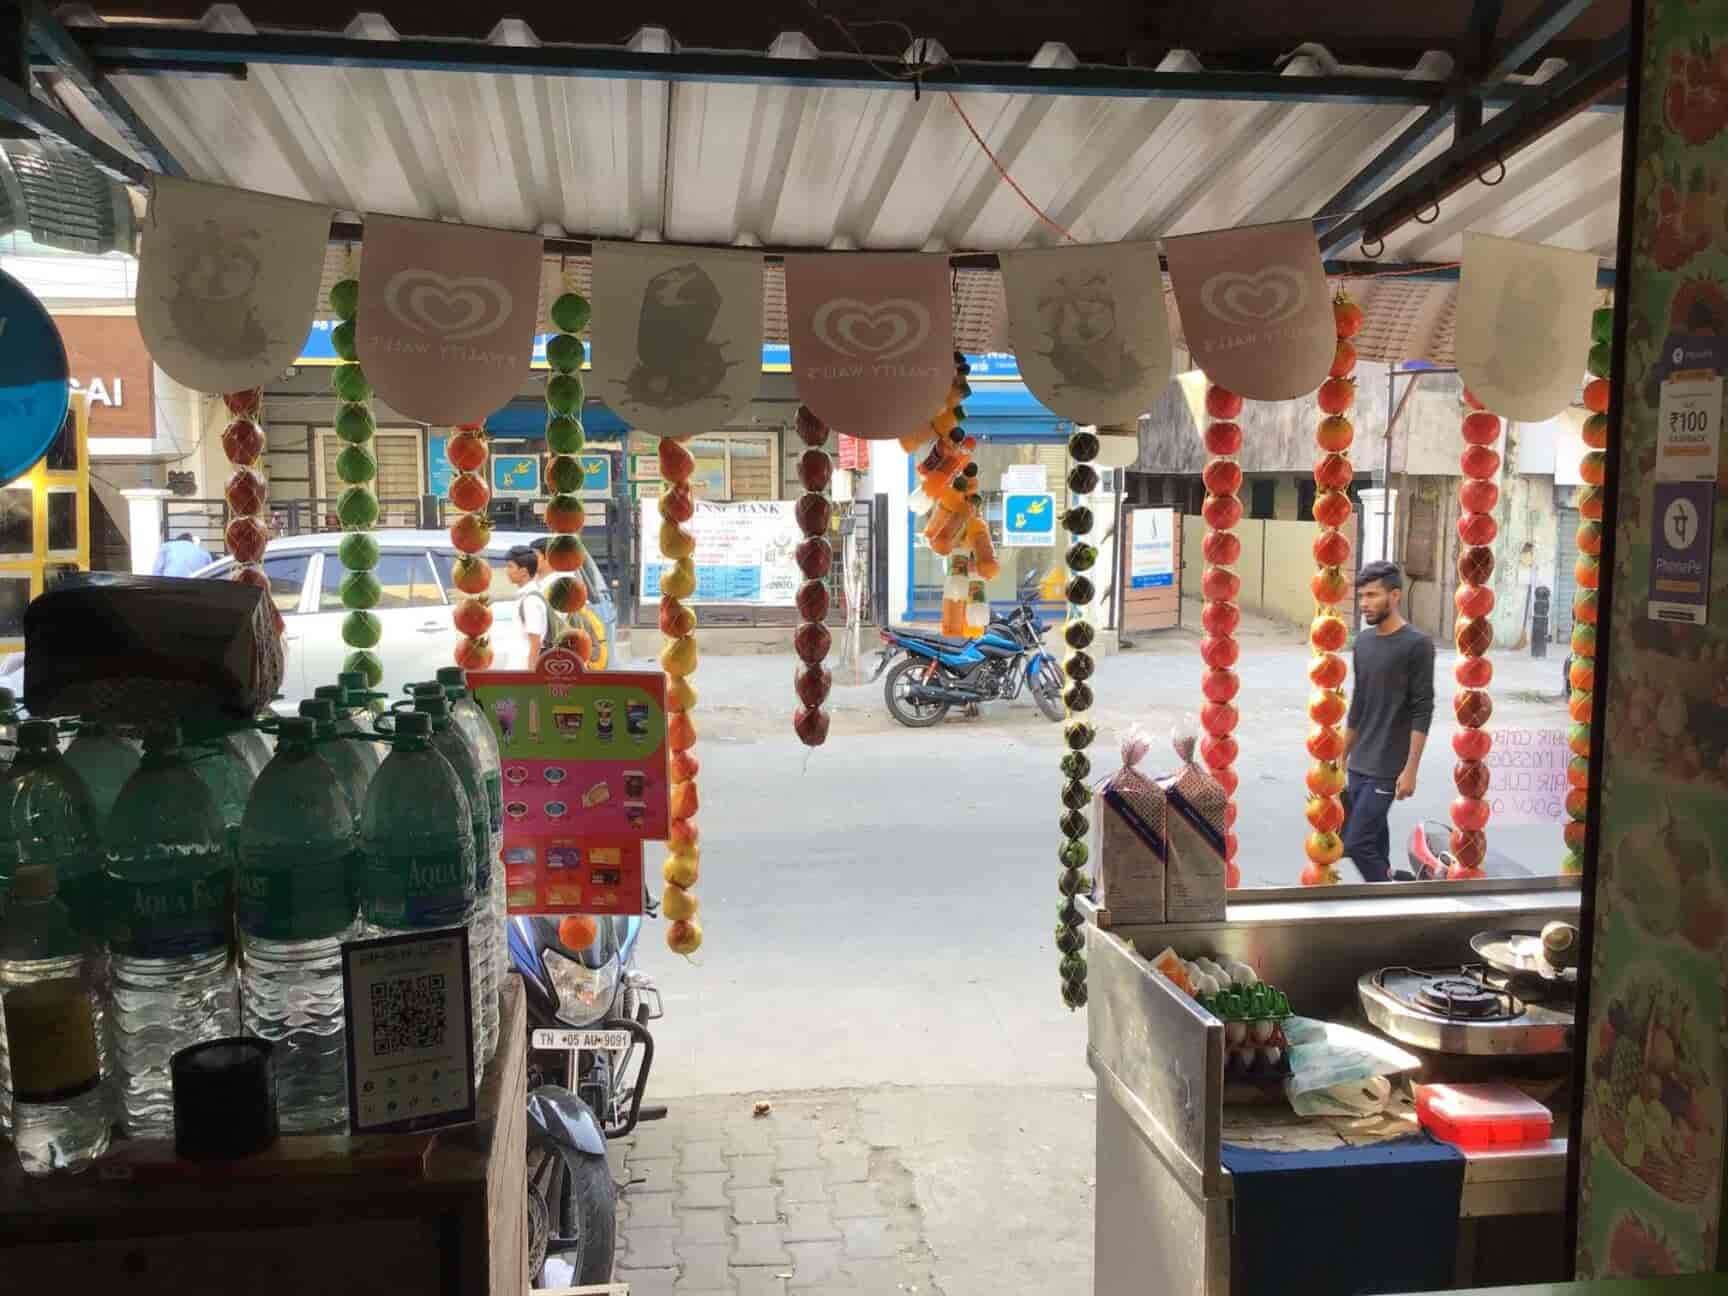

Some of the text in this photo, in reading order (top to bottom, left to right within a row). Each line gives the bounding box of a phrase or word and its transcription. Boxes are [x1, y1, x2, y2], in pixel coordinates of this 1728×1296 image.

[1670, 411, 1707, 432] ₹100
[737, 502, 780, 515] BANK
[540, 1032, 554, 1046] TN
